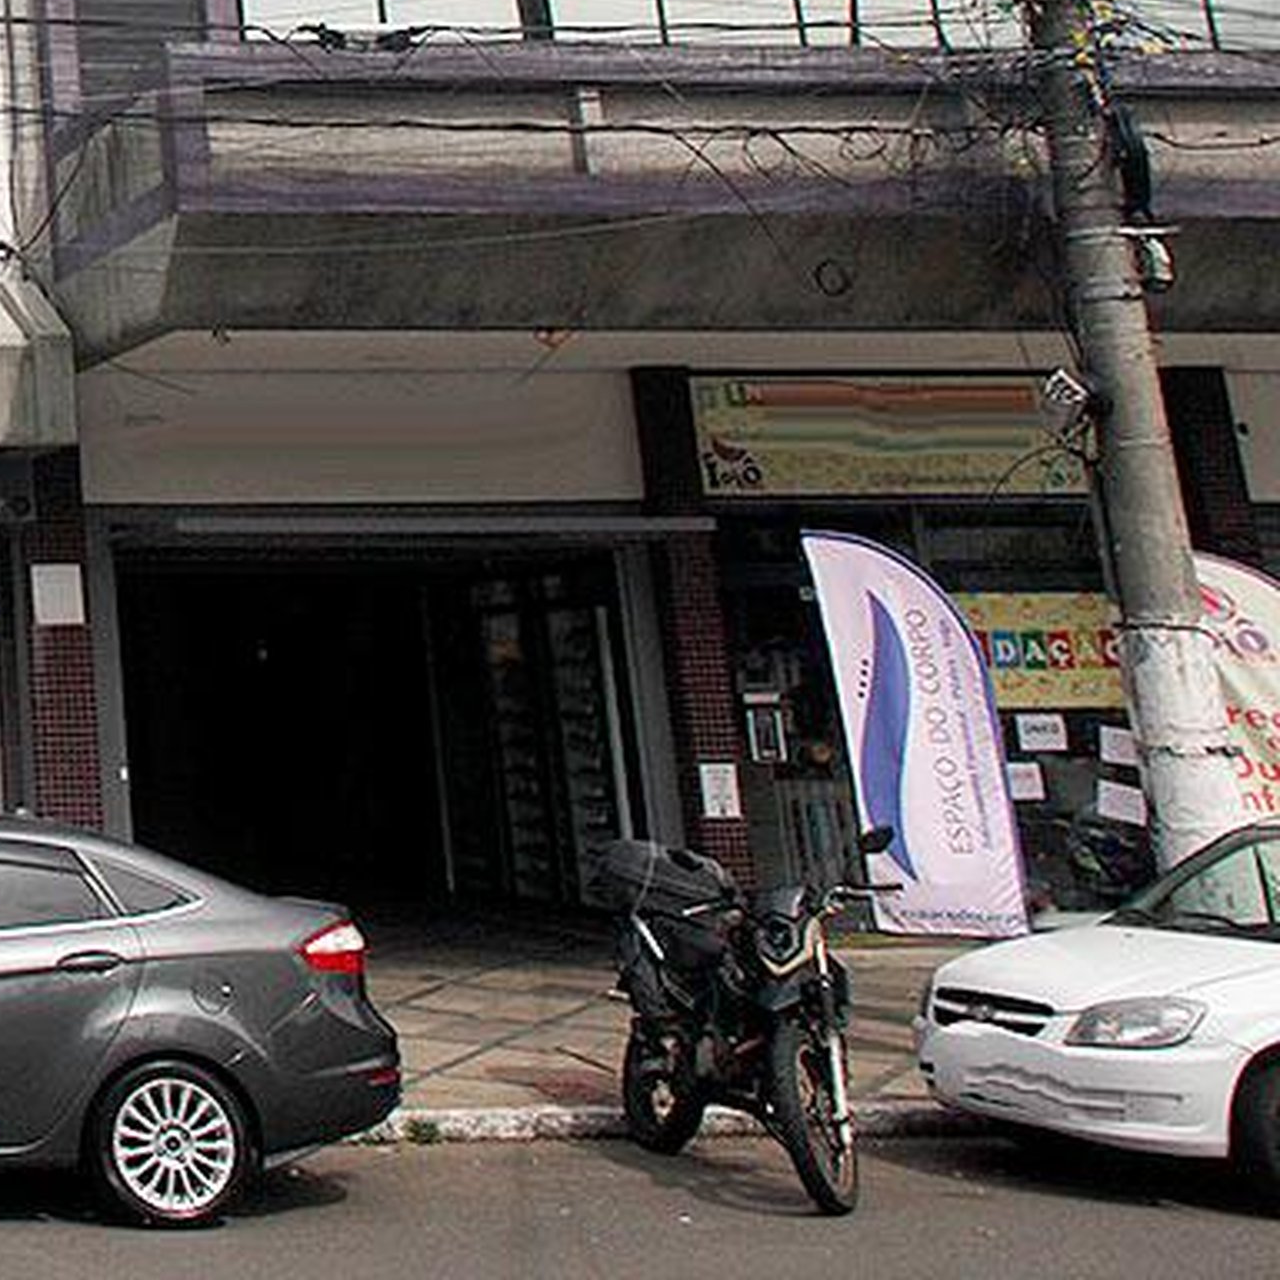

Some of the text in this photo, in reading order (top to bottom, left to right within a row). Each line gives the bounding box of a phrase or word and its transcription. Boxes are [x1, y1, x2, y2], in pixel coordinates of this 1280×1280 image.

[905, 608, 940, 695] CORPO
[925, 706, 951, 745] DO
[933, 756, 974, 855] ESPAÇO
